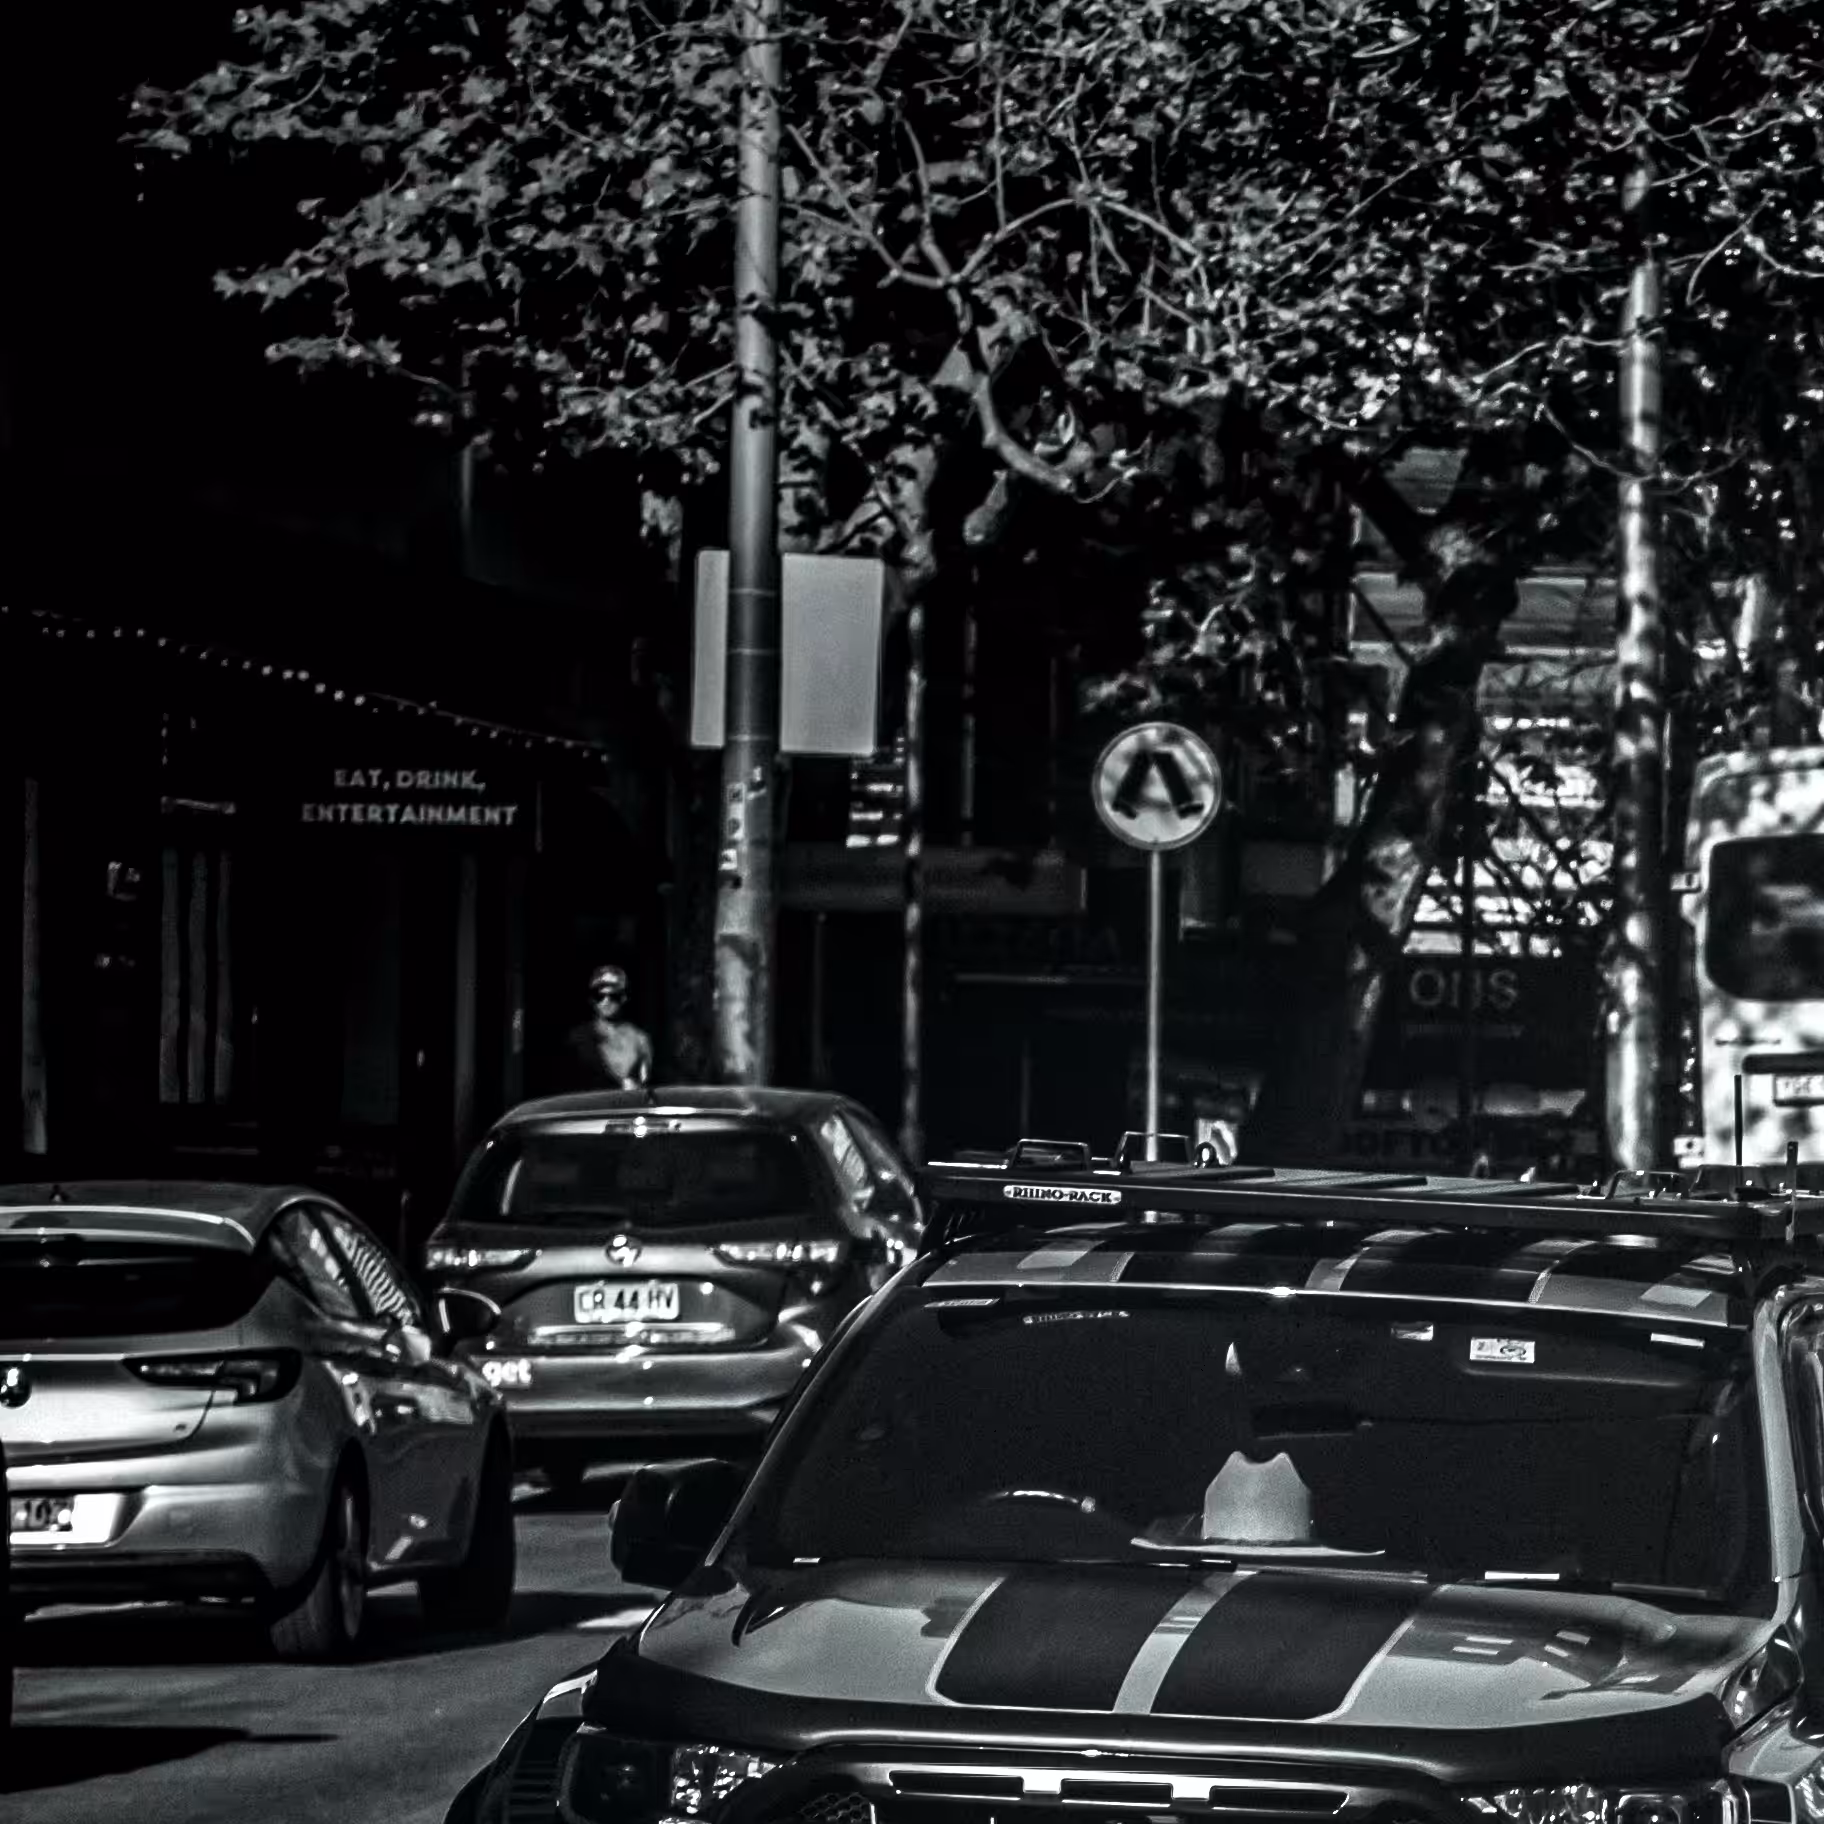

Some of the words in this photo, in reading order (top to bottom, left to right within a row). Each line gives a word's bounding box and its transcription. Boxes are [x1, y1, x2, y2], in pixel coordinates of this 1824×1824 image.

[334, 769, 390, 792] EAT,
[396, 769, 486, 793] DRINK,
[301, 802, 519, 826] ENTERTAINMENT
[1011, 1186, 1113, 1204] RHINO-RACK
[613, 1288, 640, 1311] 44
[482, 1358, 532, 1387] get
